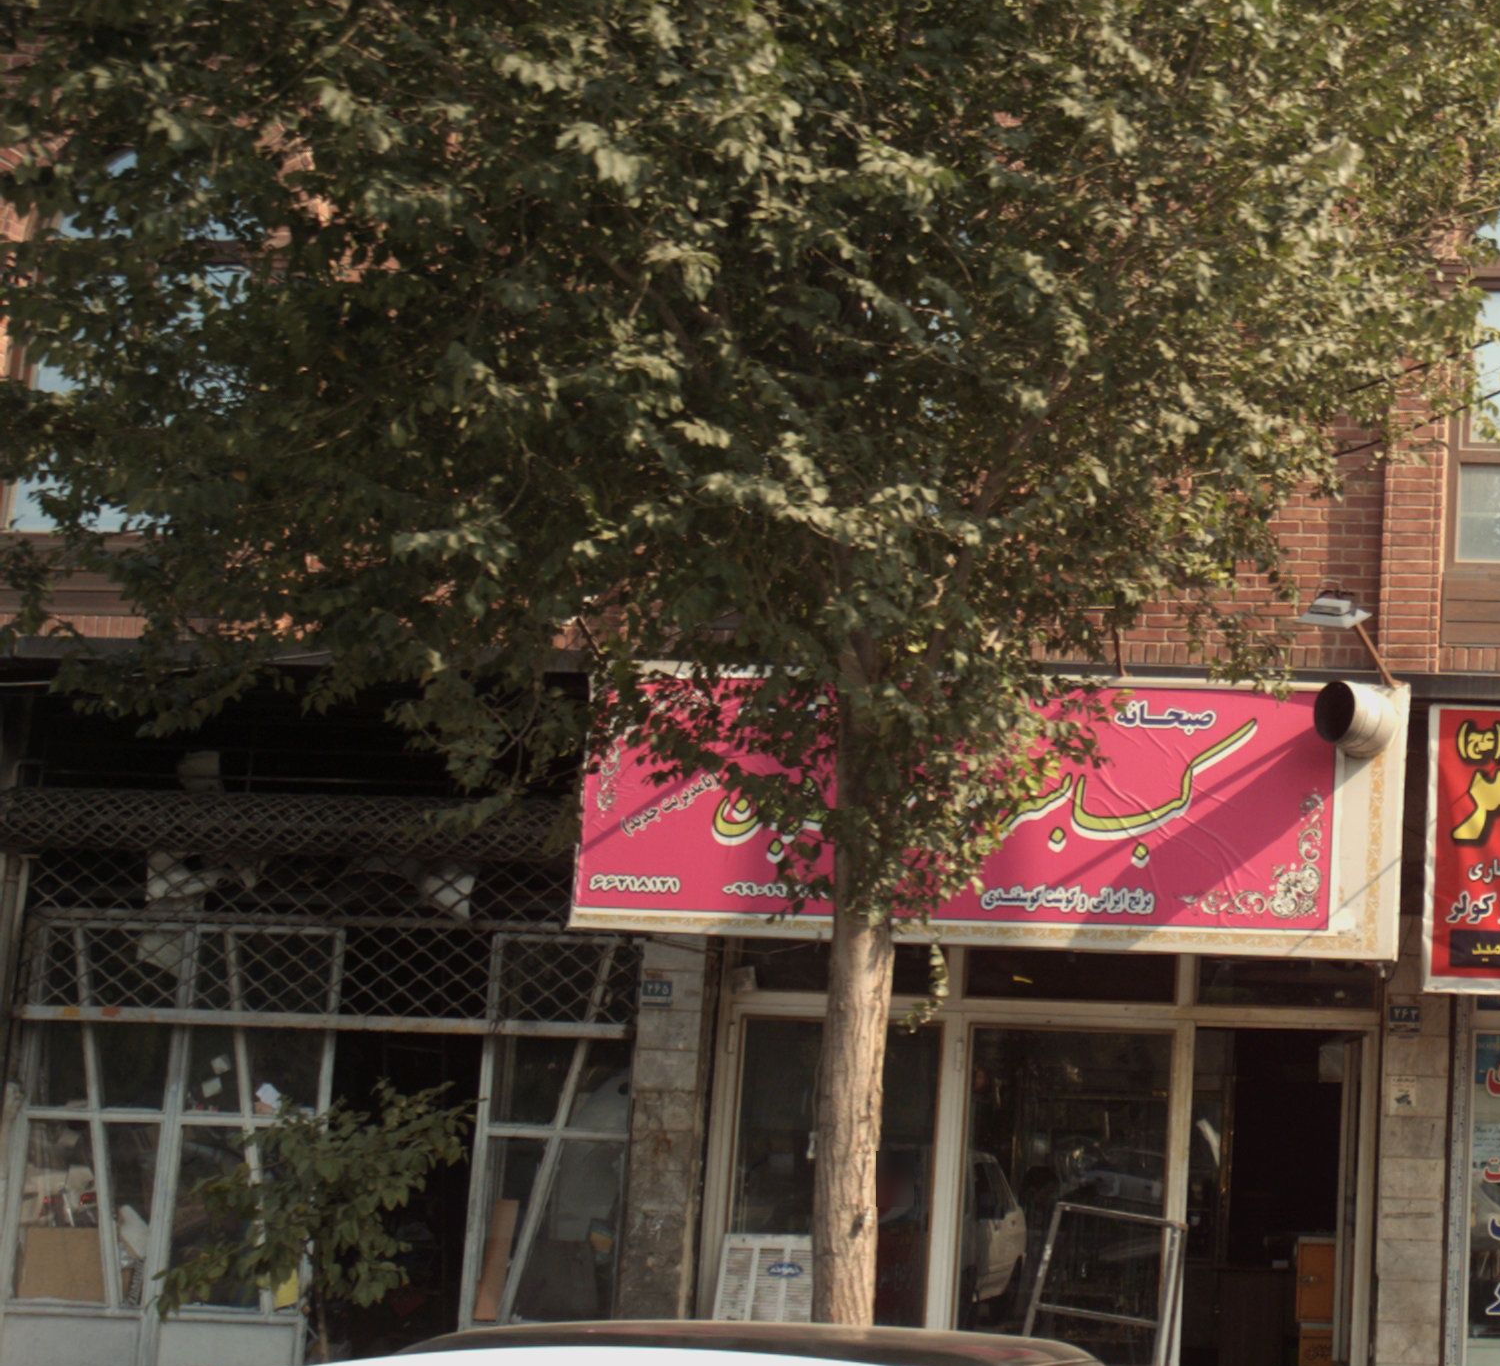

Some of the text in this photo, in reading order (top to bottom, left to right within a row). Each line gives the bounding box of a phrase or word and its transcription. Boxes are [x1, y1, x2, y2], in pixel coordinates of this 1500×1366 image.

[1115, 701, 1216, 734] صبحانه
[1090, 887, 1126, 913] ایرانی
[1127, 888, 1155, 913] برنج
[1446, 891, 1497, 925] کولر
